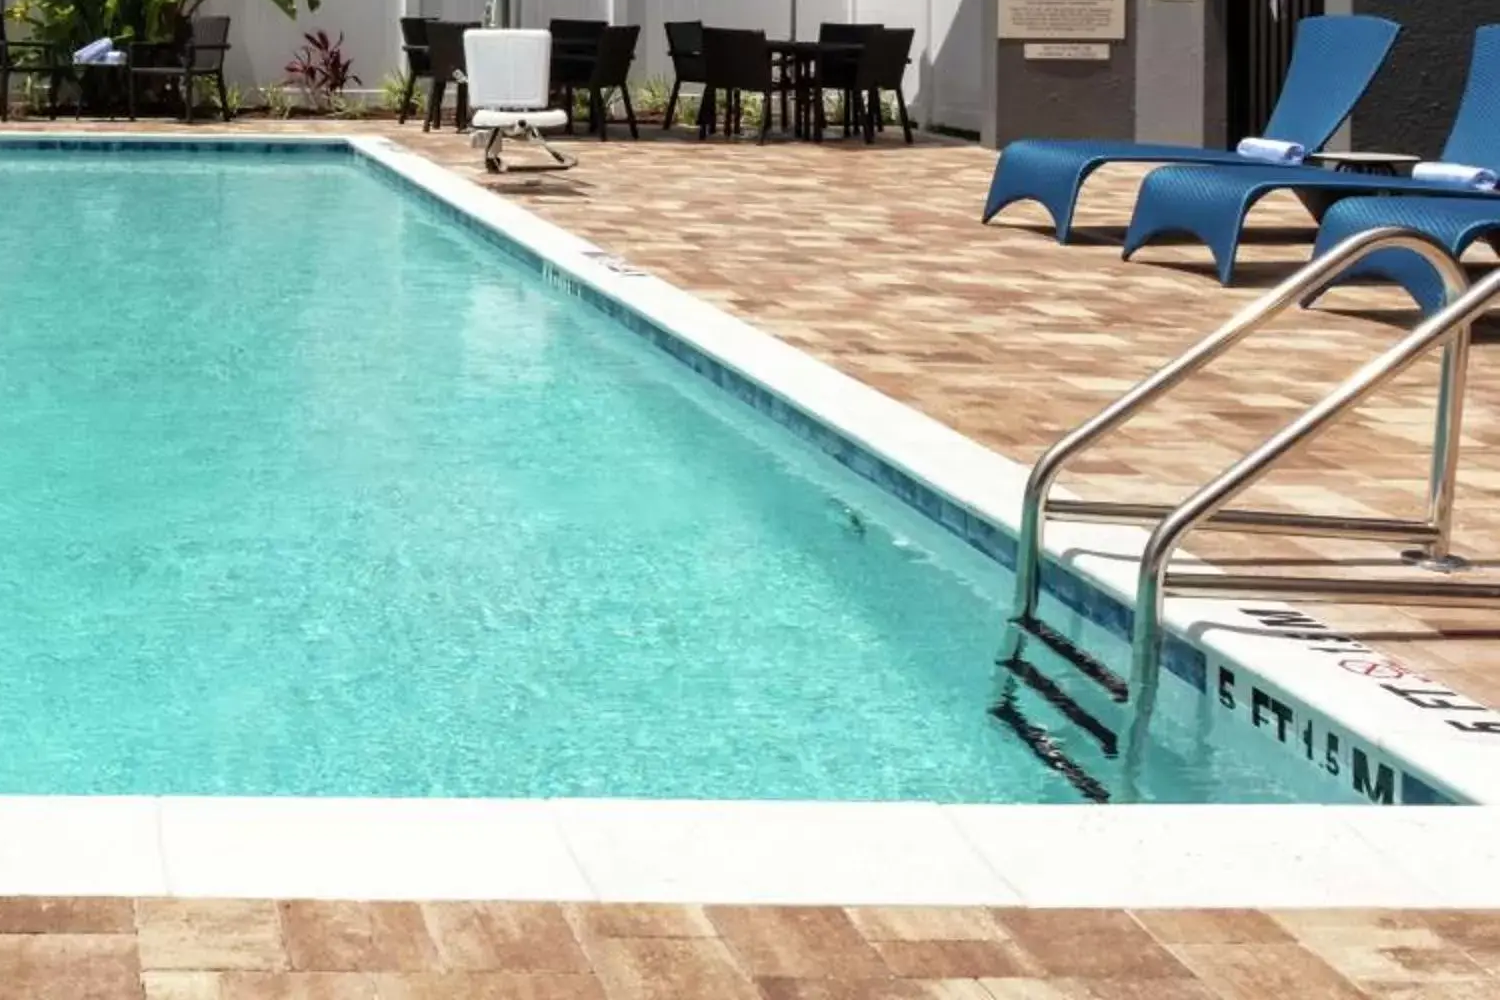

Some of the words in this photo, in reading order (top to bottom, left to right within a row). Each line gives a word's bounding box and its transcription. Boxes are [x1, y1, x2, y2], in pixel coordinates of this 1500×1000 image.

[1239, 608, 1328, 629] M
[1379, 684, 1487, 710] FT
[1219, 665, 1236, 710] 5
[1252, 686, 1293, 743] FT
[1352, 746, 1395, 805] M
